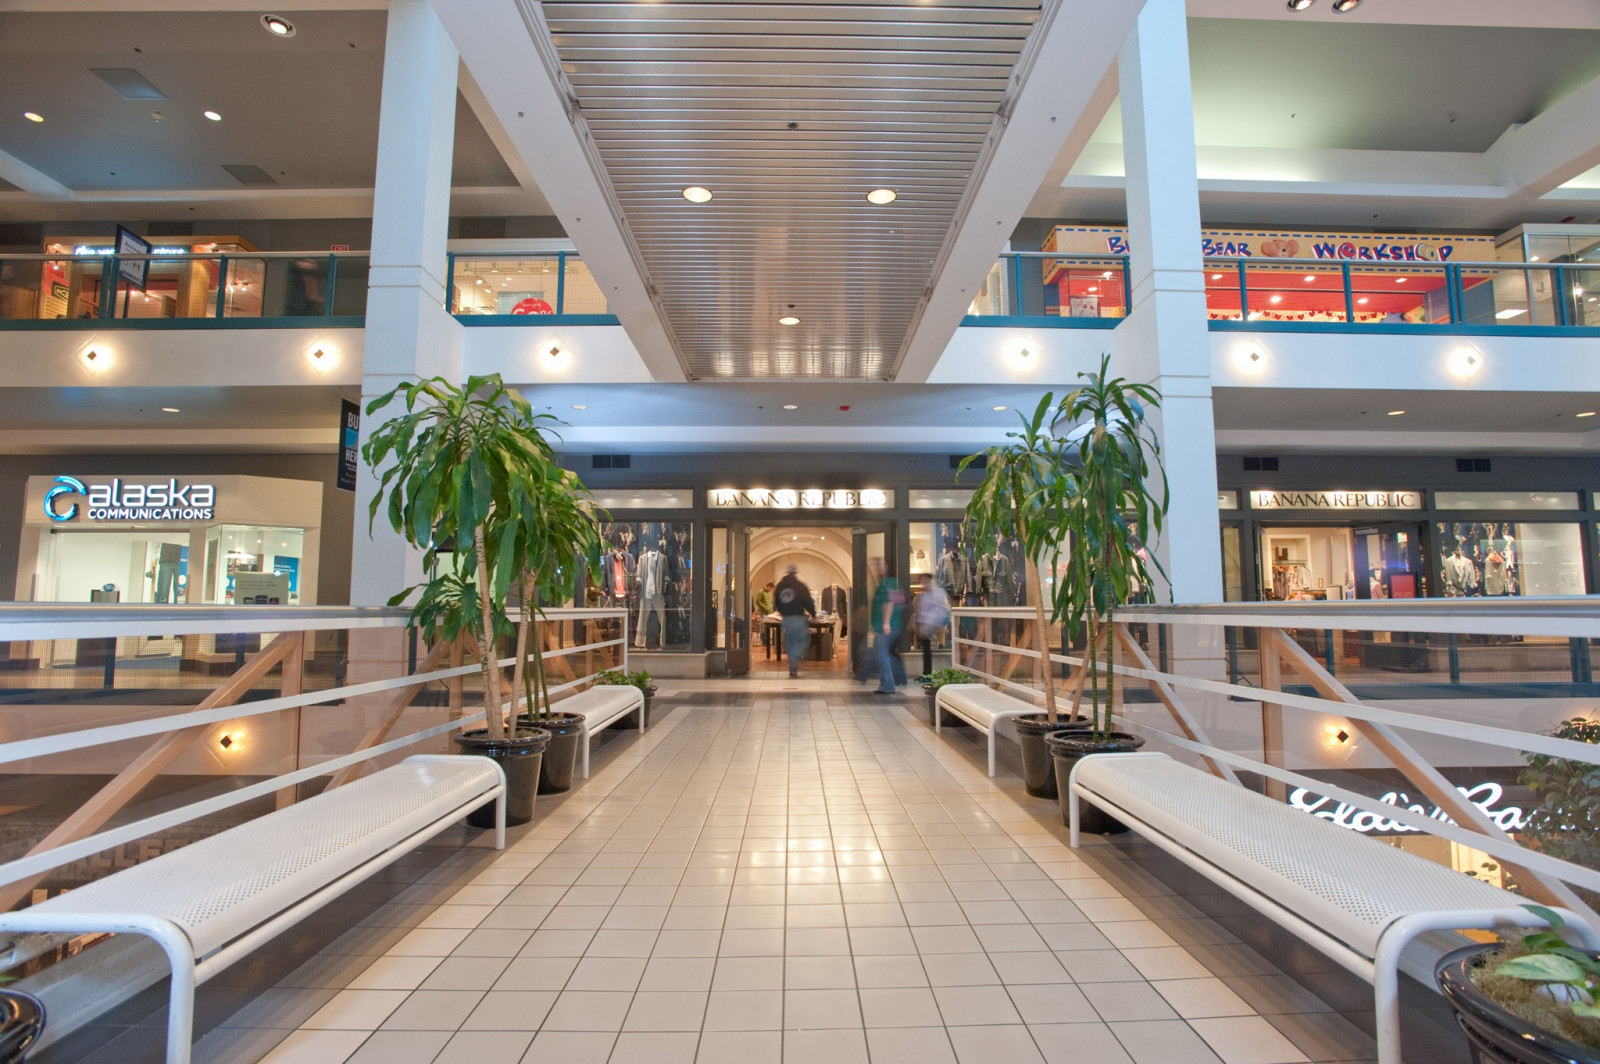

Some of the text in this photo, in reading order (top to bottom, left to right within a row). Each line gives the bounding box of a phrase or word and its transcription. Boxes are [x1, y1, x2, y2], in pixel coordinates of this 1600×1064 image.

[1311, 241, 1454, 262] WORKSHOP
[347, 411, 360, 430] BU
[345, 448, 358, 463] HER
[88, 477, 215, 507] alaska
[798, 491, 887, 507] RPUBLIC
[1258, 493, 1415, 507] BANANA REPUBLIC
[87, 507, 213, 520] COMMUNICATIONS
